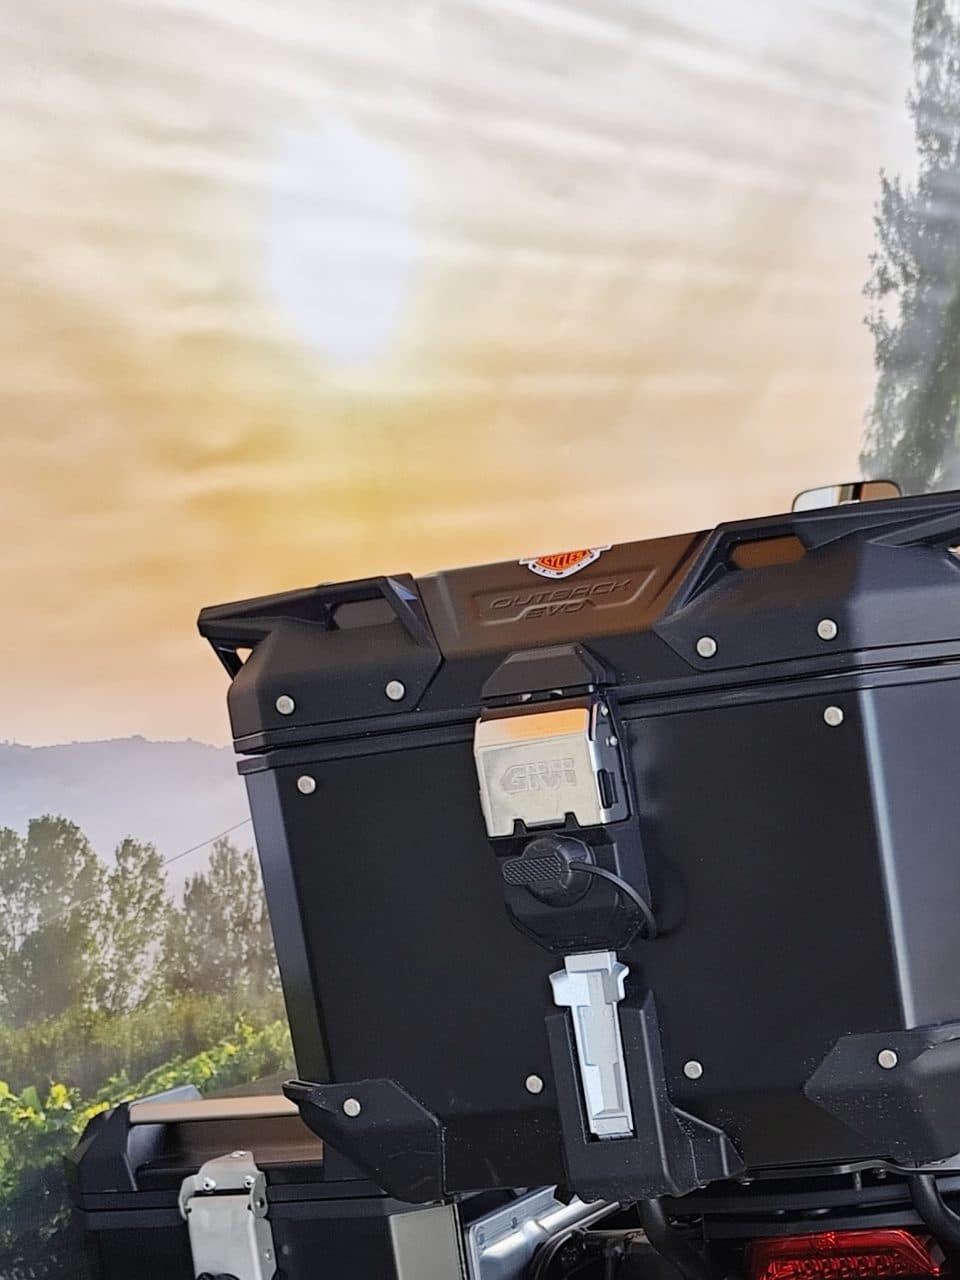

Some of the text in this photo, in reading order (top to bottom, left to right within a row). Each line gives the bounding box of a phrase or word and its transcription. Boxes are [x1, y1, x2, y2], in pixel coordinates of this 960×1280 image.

[489, 579, 631, 609] OUTBACK
[525, 601, 586, 619] EVO
[501, 757, 577, 796] GIVI
